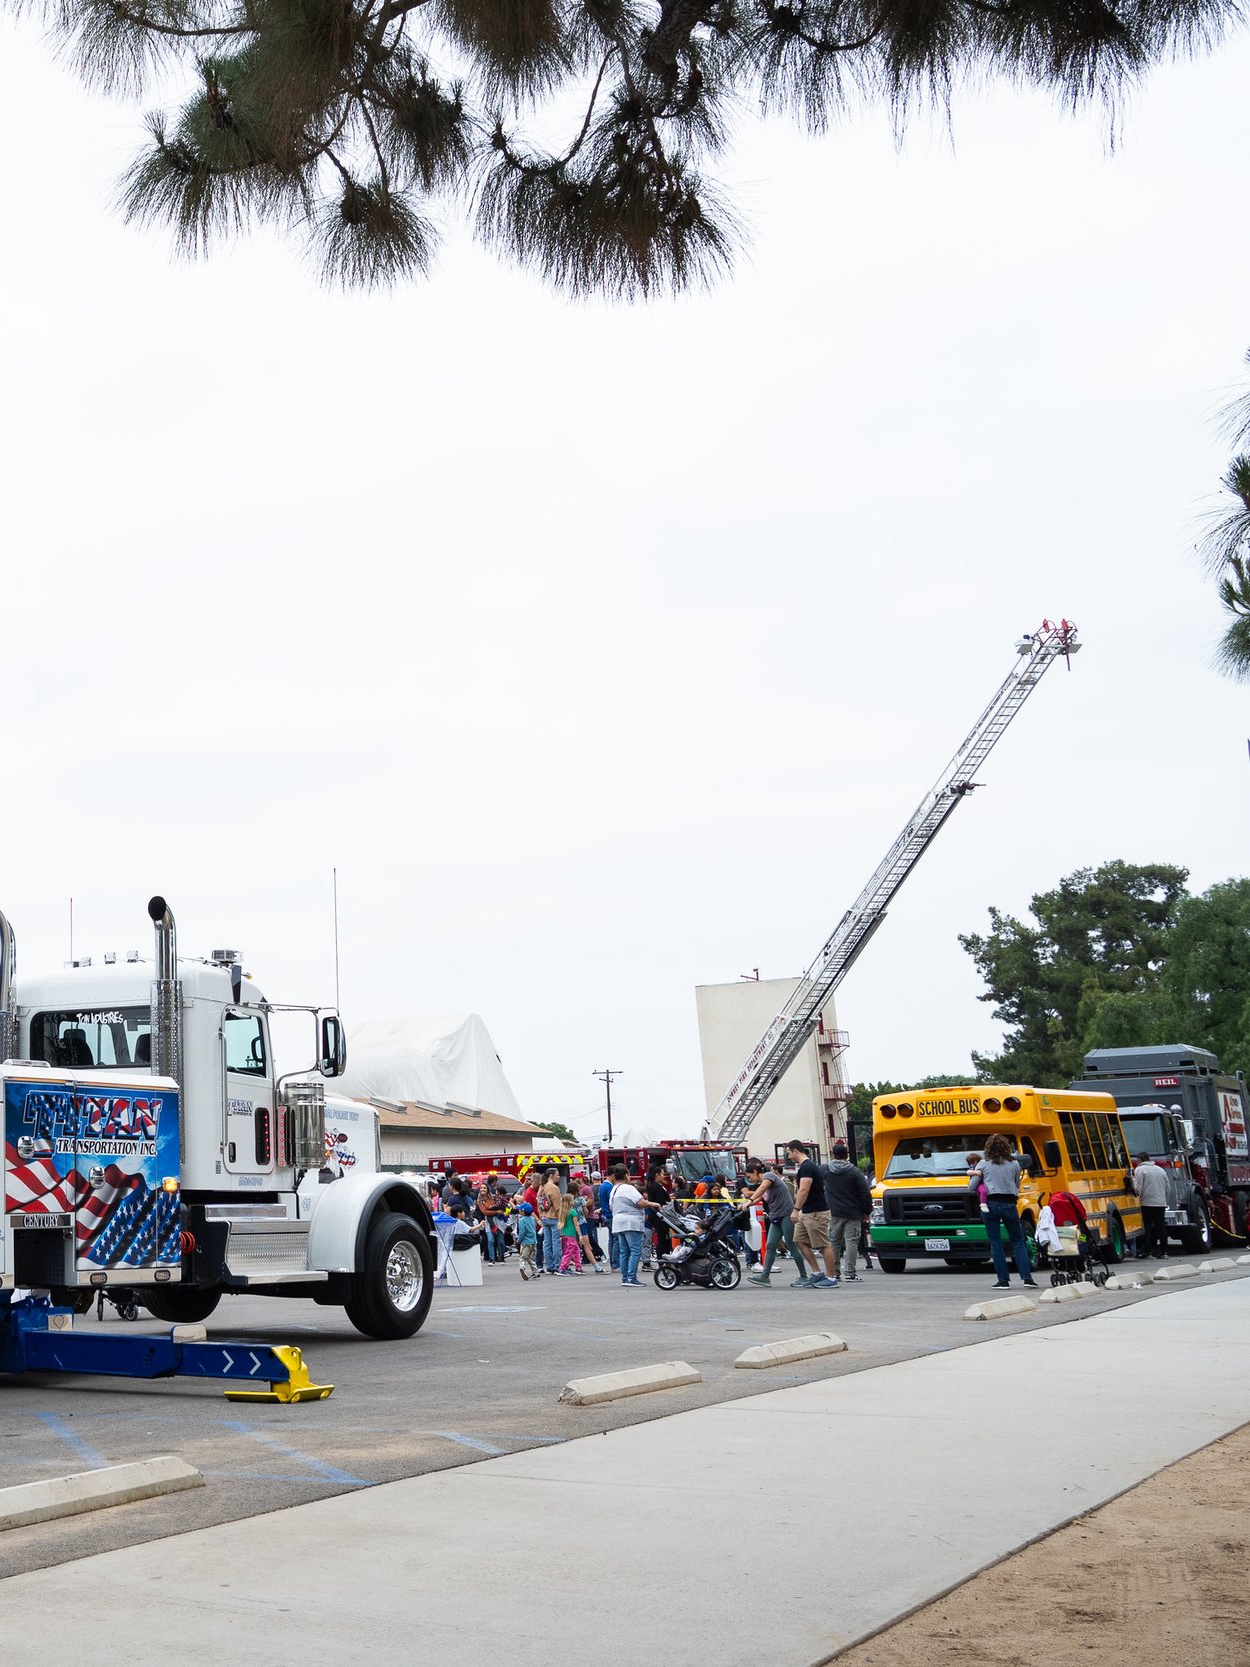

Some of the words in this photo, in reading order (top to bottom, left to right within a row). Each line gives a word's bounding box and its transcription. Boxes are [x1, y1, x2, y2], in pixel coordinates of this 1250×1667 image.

[918, 1101, 957, 1116] SCHOOL
[959, 1099, 980, 1115] BUS
[23, 1090, 163, 1159] TITAN
[57, 1137, 137, 1155] TRANSPORTATION
[139, 1141, 158, 1156] INC.
[22, 1214, 60, 1228] CENTURY
